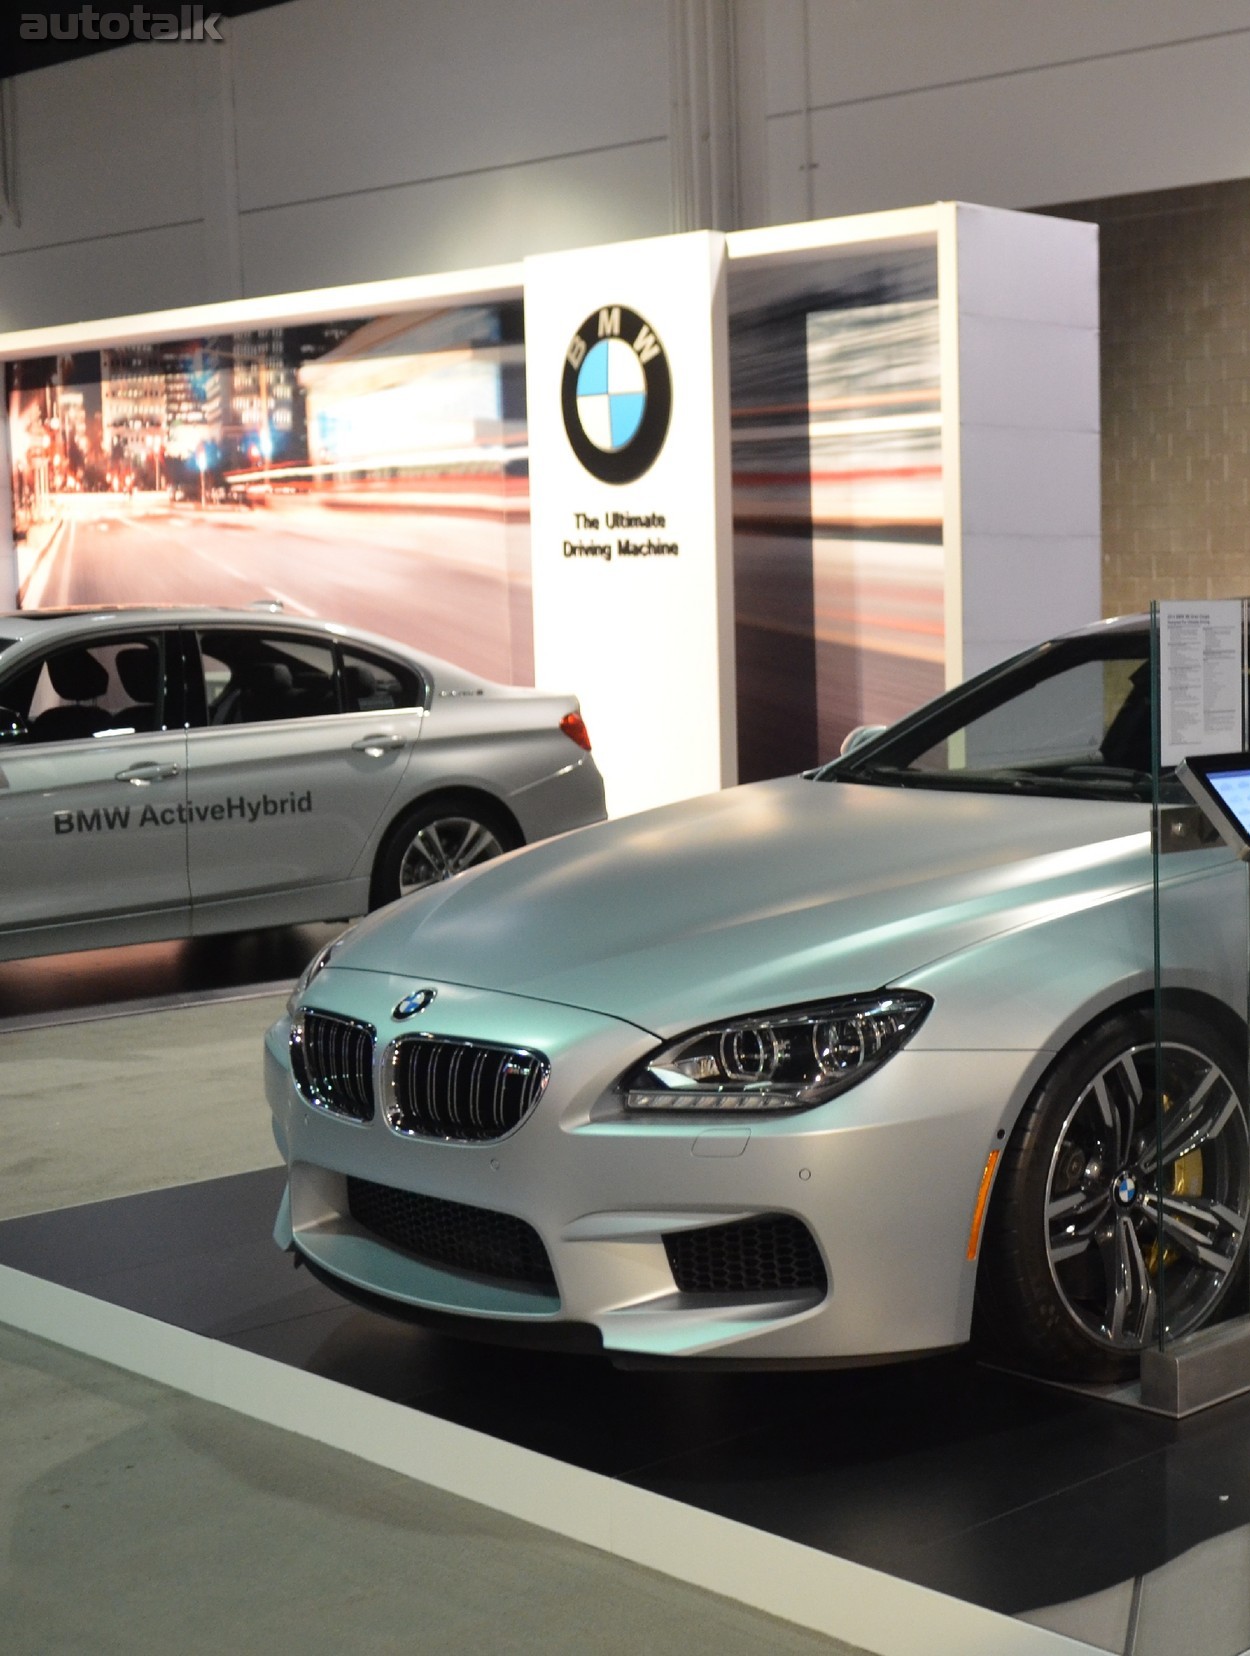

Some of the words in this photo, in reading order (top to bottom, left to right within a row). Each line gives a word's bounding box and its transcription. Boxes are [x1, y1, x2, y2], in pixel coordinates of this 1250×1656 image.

[566, 306, 661, 371] BMW
[574, 512, 600, 530] The
[605, 511, 666, 530] Ultimate
[563, 540, 612, 561] Driving
[617, 538, 679, 556] Machine
[53, 806, 131, 835] BMW
[139, 790, 313, 828] ActiveHybrid
